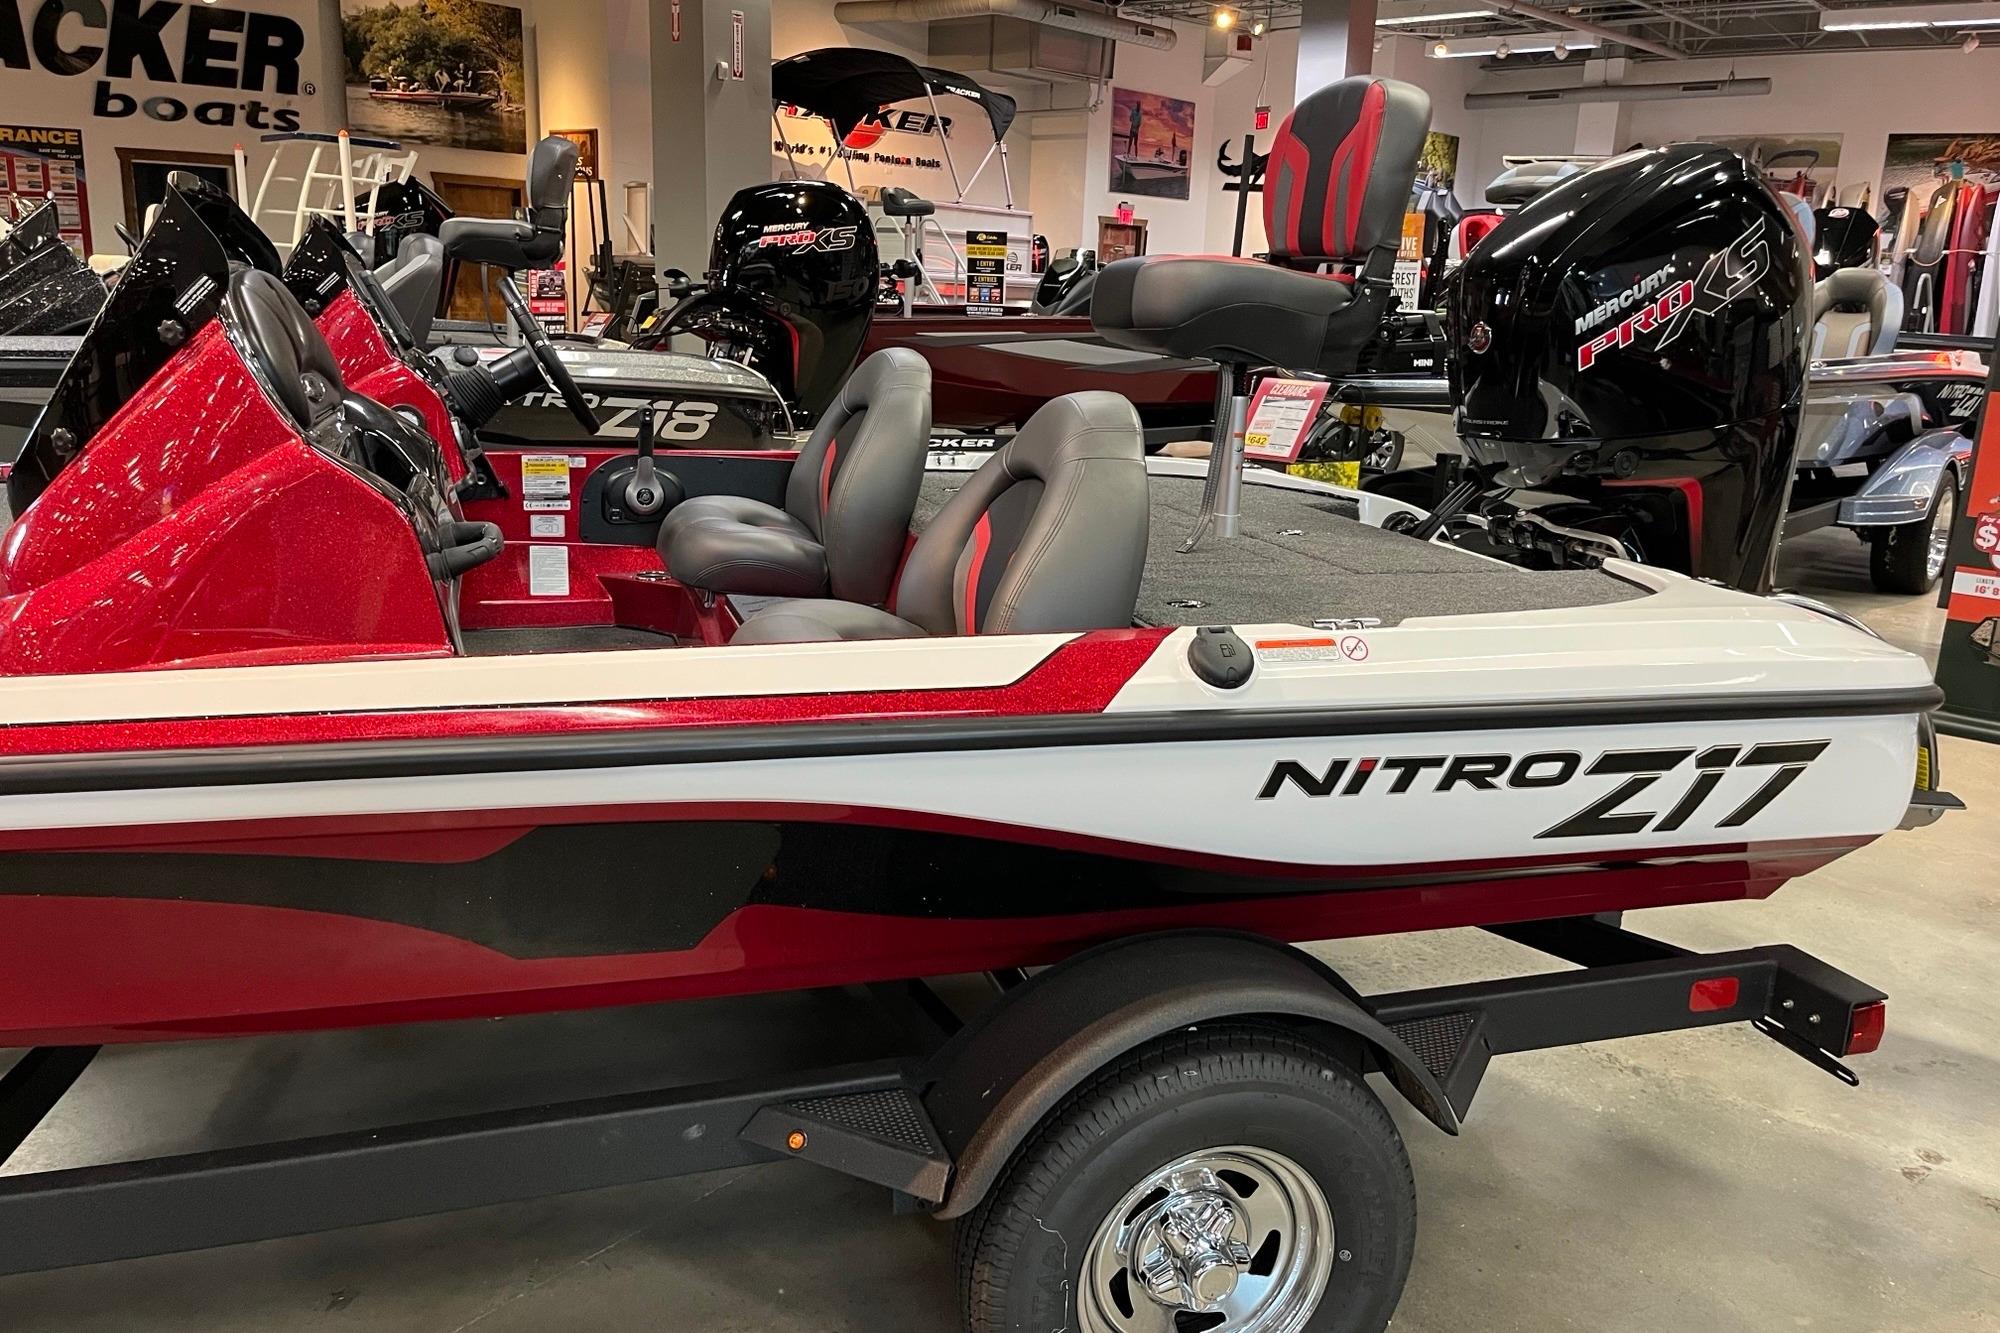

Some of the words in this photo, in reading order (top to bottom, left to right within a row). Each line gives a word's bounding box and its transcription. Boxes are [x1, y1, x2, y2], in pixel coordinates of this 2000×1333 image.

[93, 80, 300, 132] boats
[759, 230, 817, 248] PRO
[792, 226, 858, 255] XS
[763, 222, 810, 233] MERCURY
[1575, 264, 1671, 335] MERCURY
[1578, 279, 1695, 372] PRO
[1654, 215, 1770, 352] XS
[1270, 384, 1315, 397] CLEARANCE
[593, 396, 719, 440] Z18
[1981, 515, 1996, 523] For
[1254, 751, 1583, 800] NITRO
[1533, 738, 1832, 839] Z17
